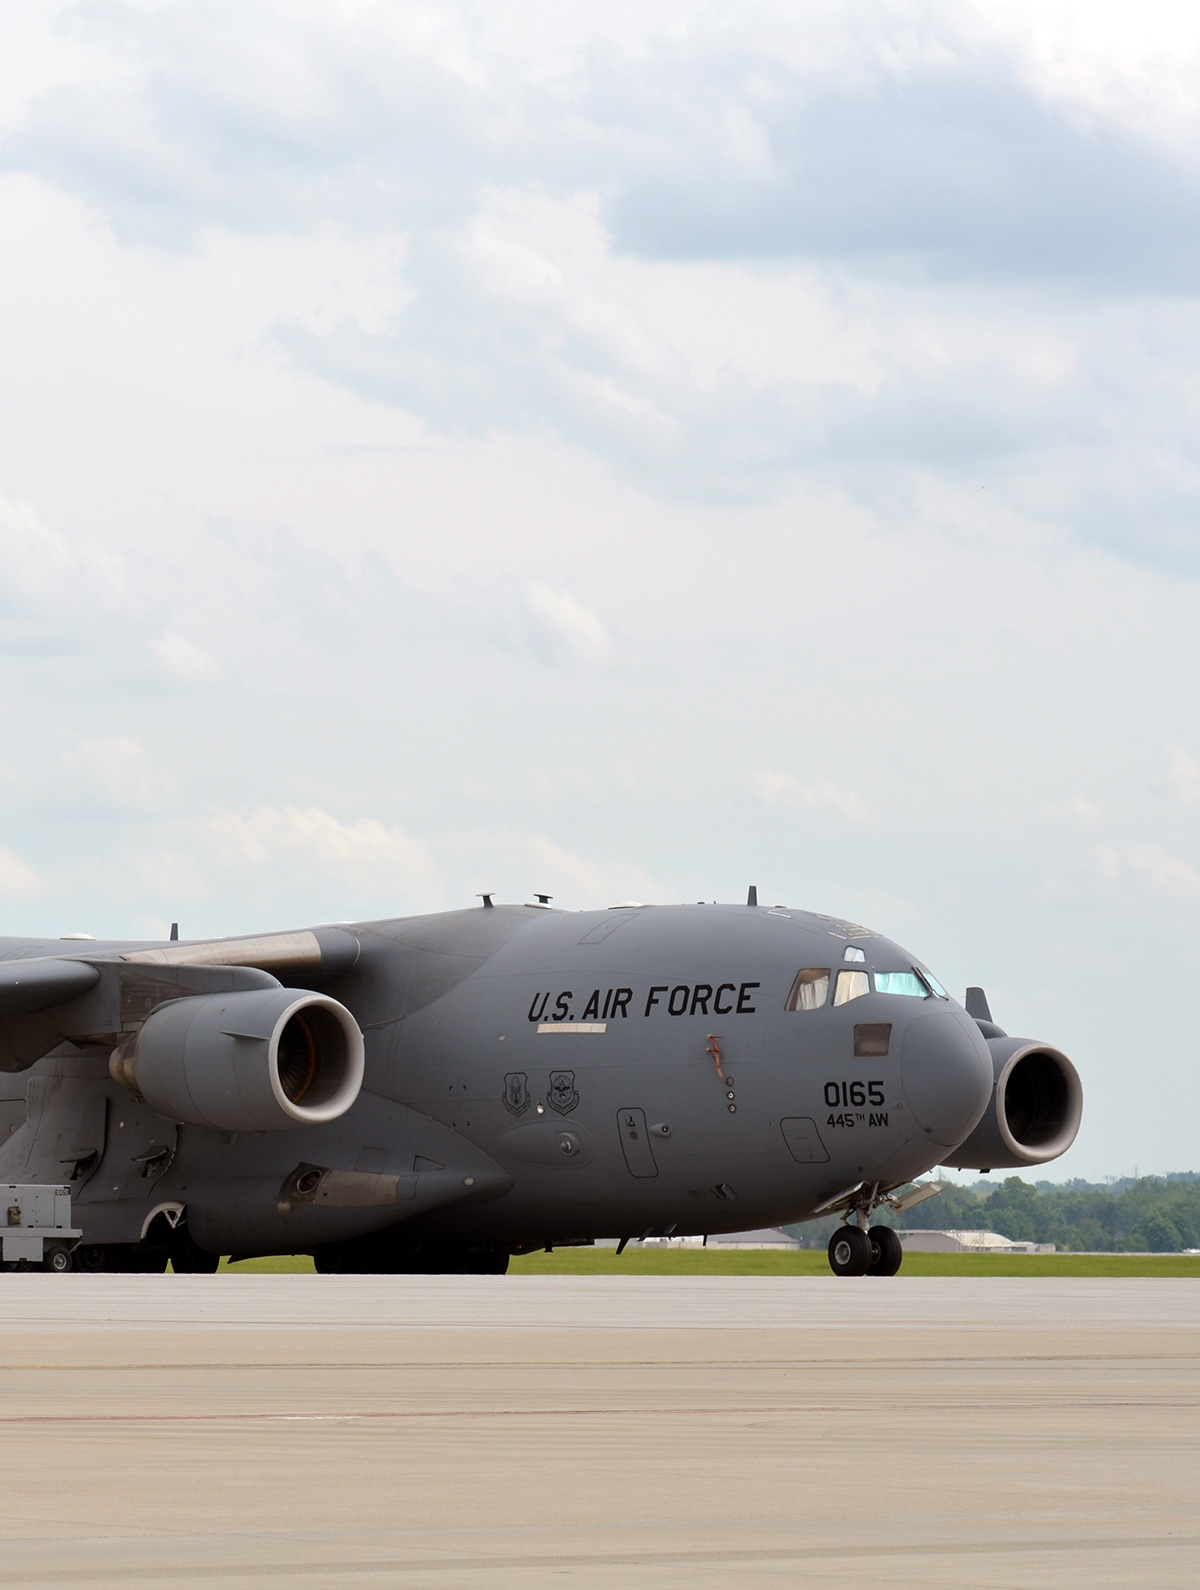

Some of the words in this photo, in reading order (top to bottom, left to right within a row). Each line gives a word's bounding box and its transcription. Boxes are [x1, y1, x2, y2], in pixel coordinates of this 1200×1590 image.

[528, 991, 574, 1023] U.S.
[581, 988, 633, 1020] AIR
[644, 982, 760, 1017] FORCE
[824, 1081, 885, 1107] 0165
[868, 1113, 888, 1127] AW
